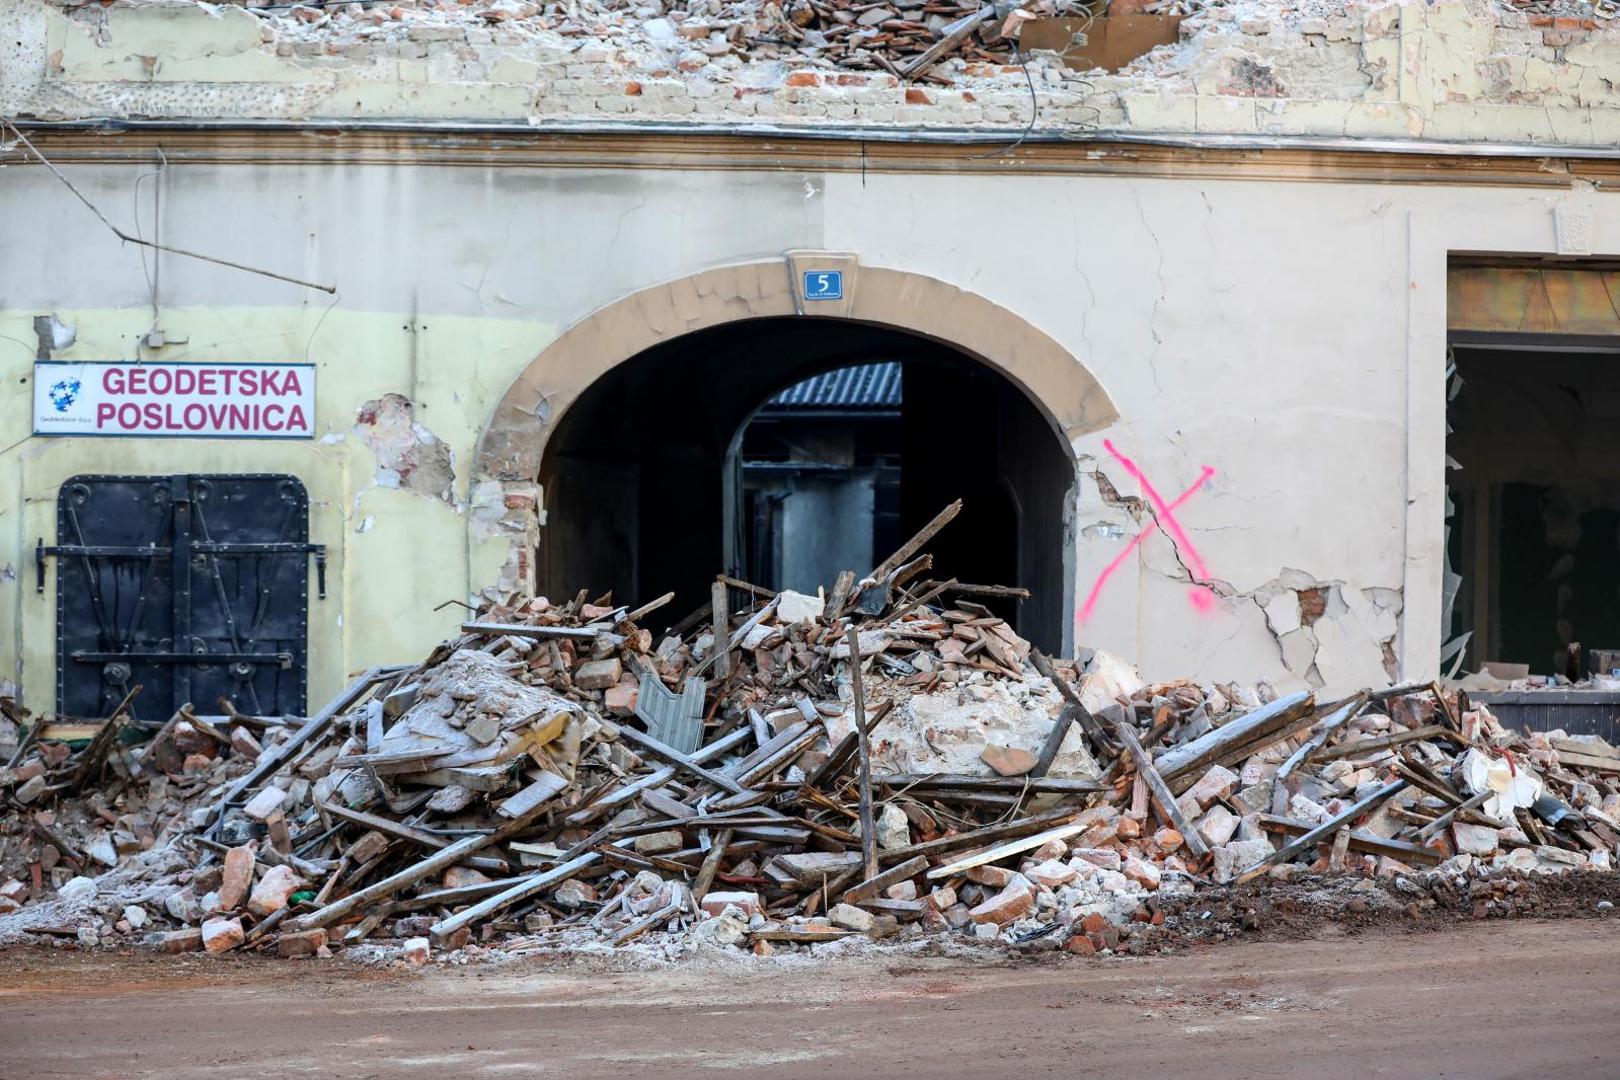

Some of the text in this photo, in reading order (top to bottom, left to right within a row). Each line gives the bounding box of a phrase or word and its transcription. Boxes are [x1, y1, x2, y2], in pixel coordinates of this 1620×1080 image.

[818, 274, 829, 292] 5
[102, 368, 302, 396] GEODETSKA
[97, 402, 307, 431] POSLOVNICA
